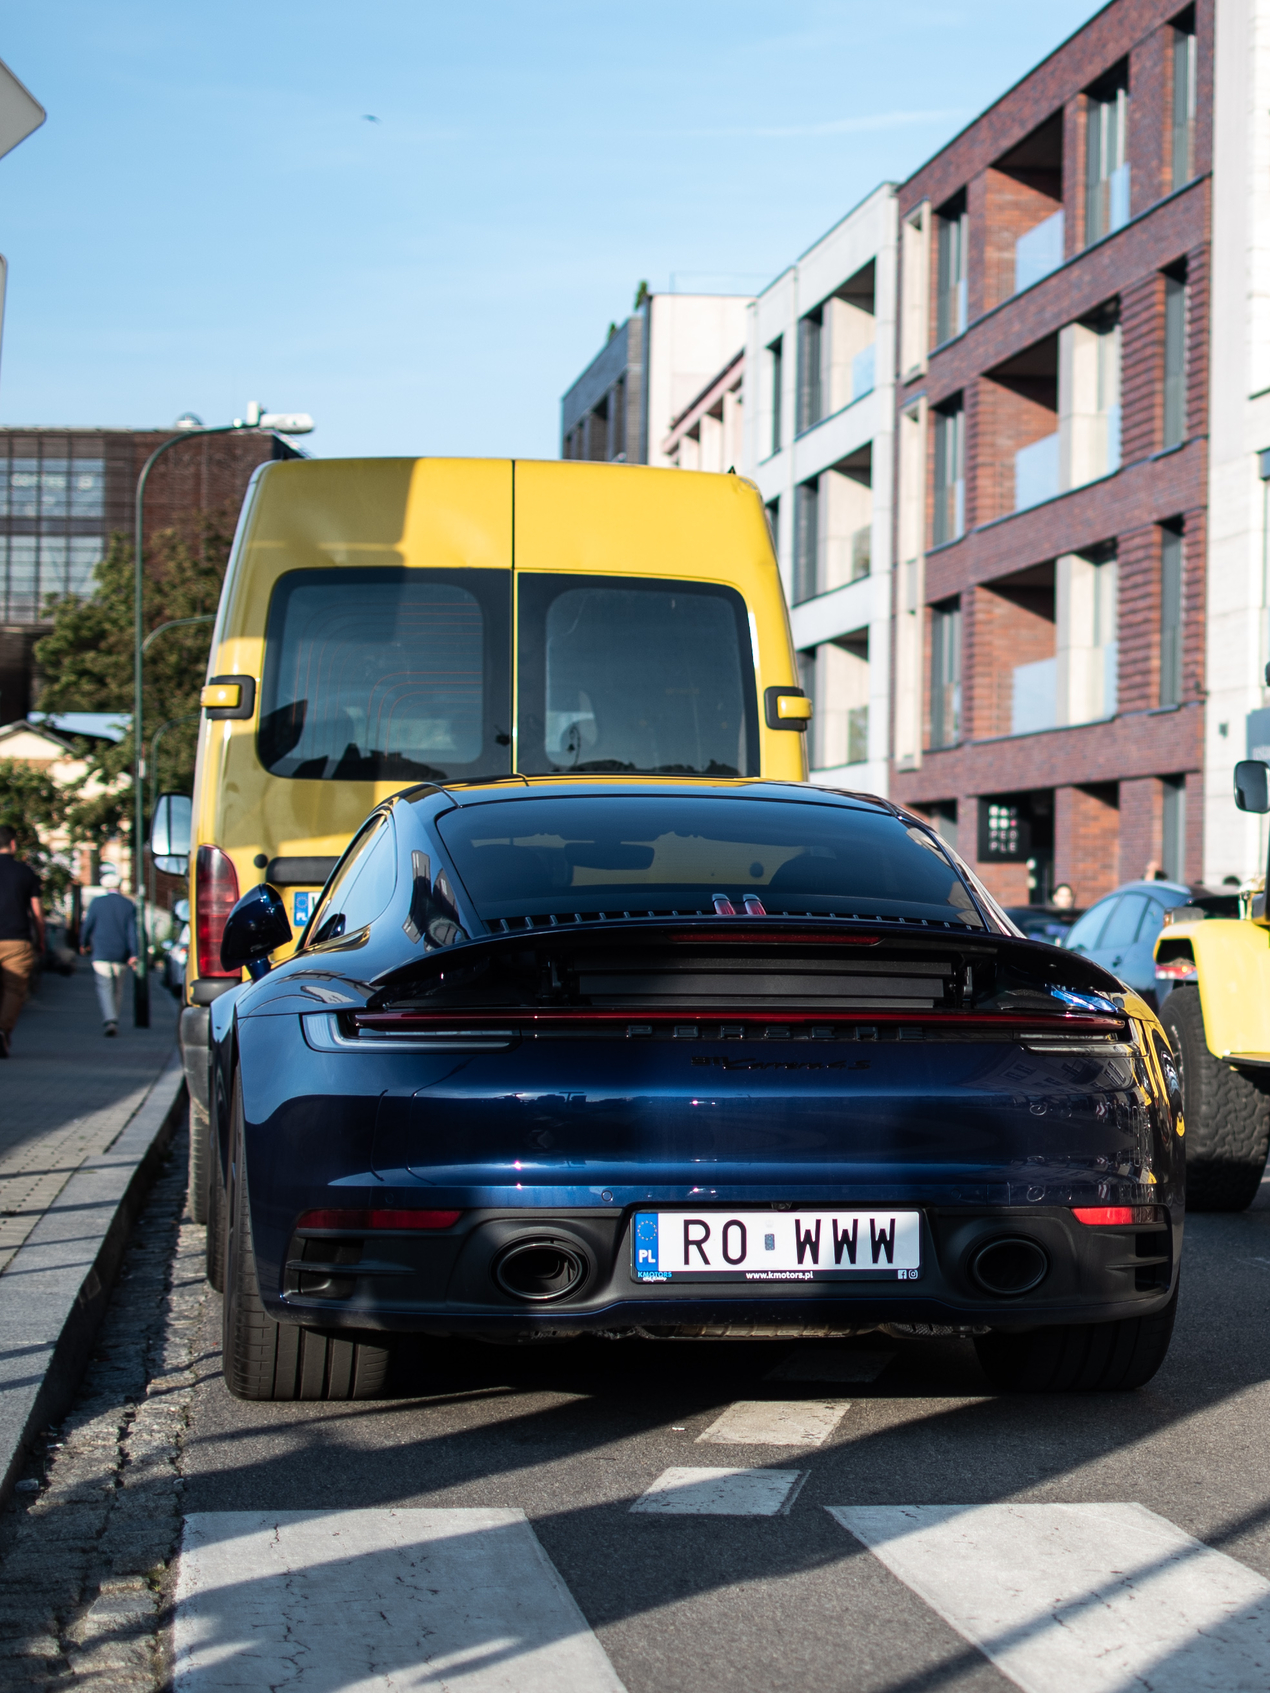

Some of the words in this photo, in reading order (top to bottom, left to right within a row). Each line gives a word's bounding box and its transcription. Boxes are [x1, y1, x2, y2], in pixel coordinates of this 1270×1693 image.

[626, 1024, 926, 1041] PORSCHE
[683, 1219, 747, 1266] RO
[795, 1218, 896, 1265] WWW
[639, 1249, 656, 1263] PL
[746, 1271, 813, 1280] www.kmotors.pl
